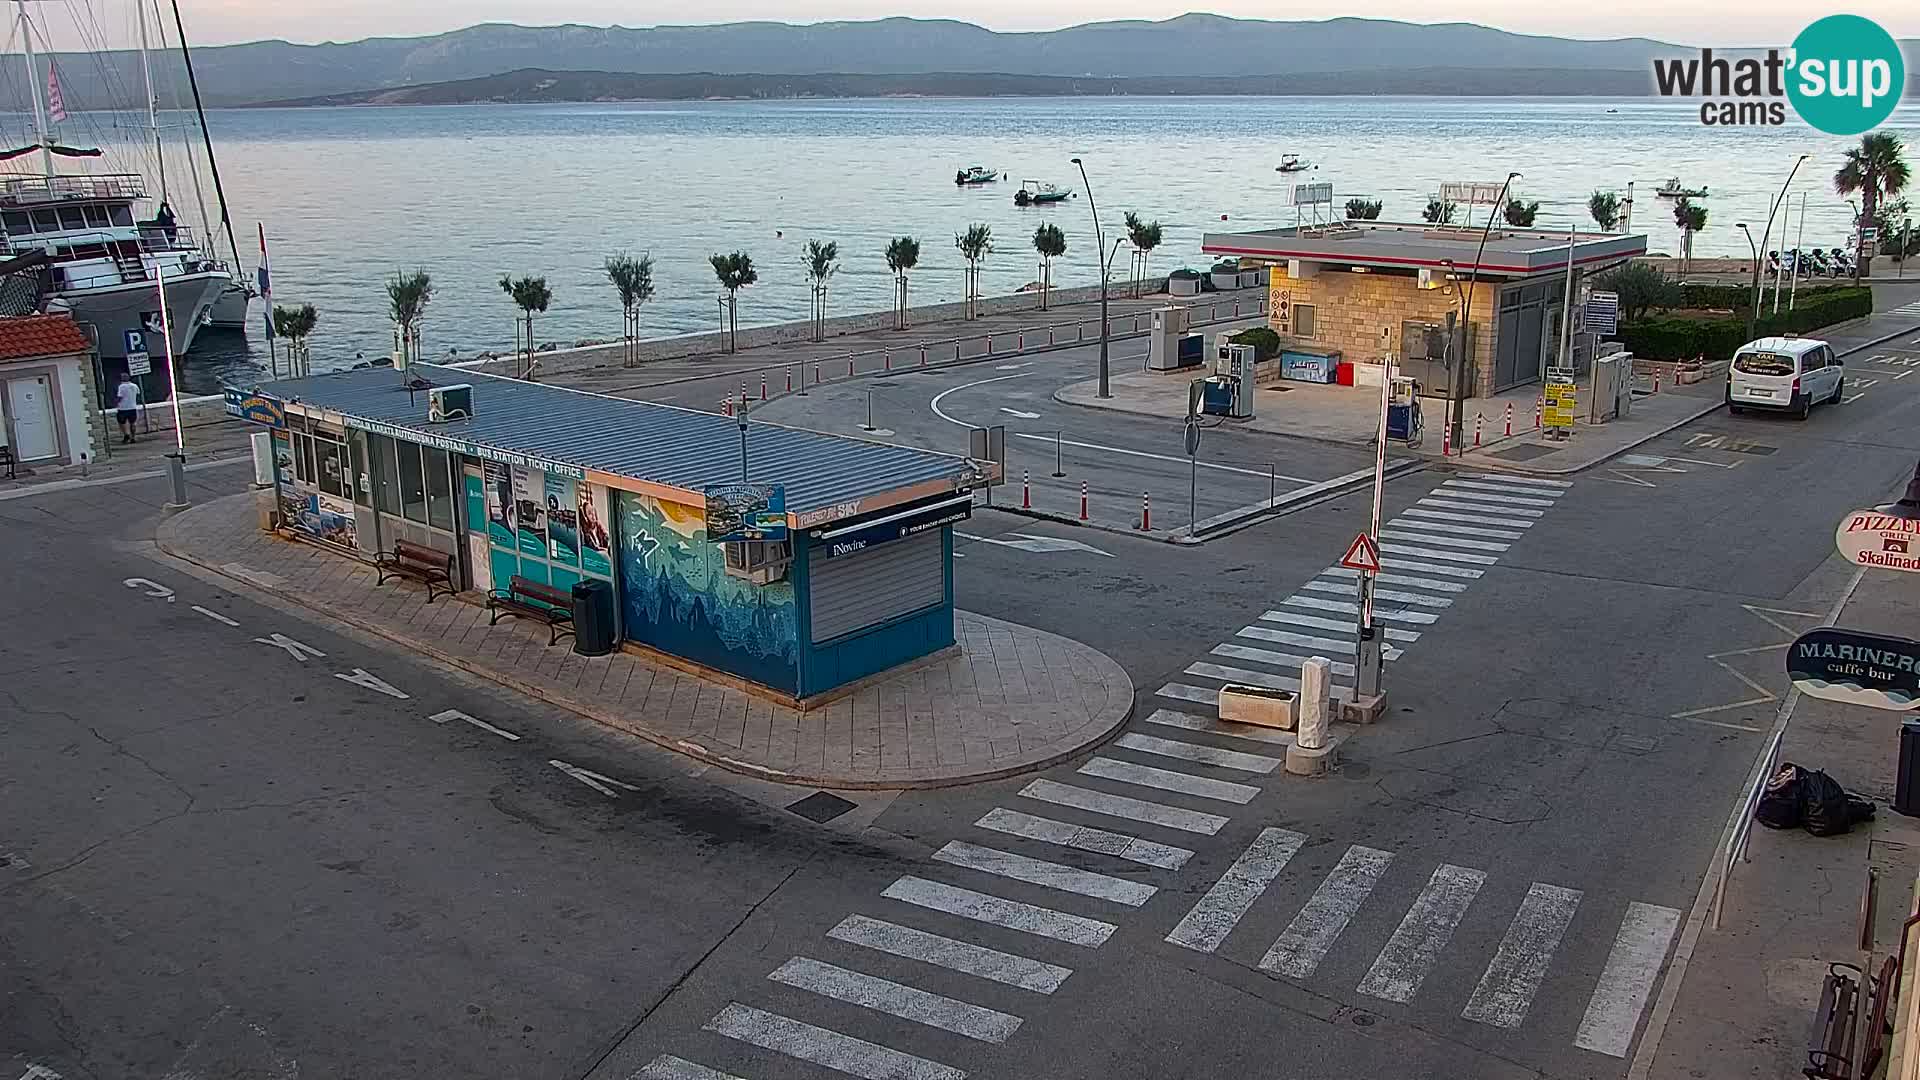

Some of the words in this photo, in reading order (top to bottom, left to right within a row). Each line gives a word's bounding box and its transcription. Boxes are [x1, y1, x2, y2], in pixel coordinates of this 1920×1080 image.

[129, 332, 142, 350] P
[395, 429, 435, 446] AUTOBUSNA
[435, 437, 467, 453] POSTAJA
[477, 447, 492, 458] BUS
[493, 450, 525, 466] STATION
[526, 458, 554, 473] TICKET
[554, 464, 581, 478] OFFICE
[1880, 531, 1914, 542] GRILL
[1827, 663, 1864, 676] caffe
[1869, 666, 1895, 681] bar
